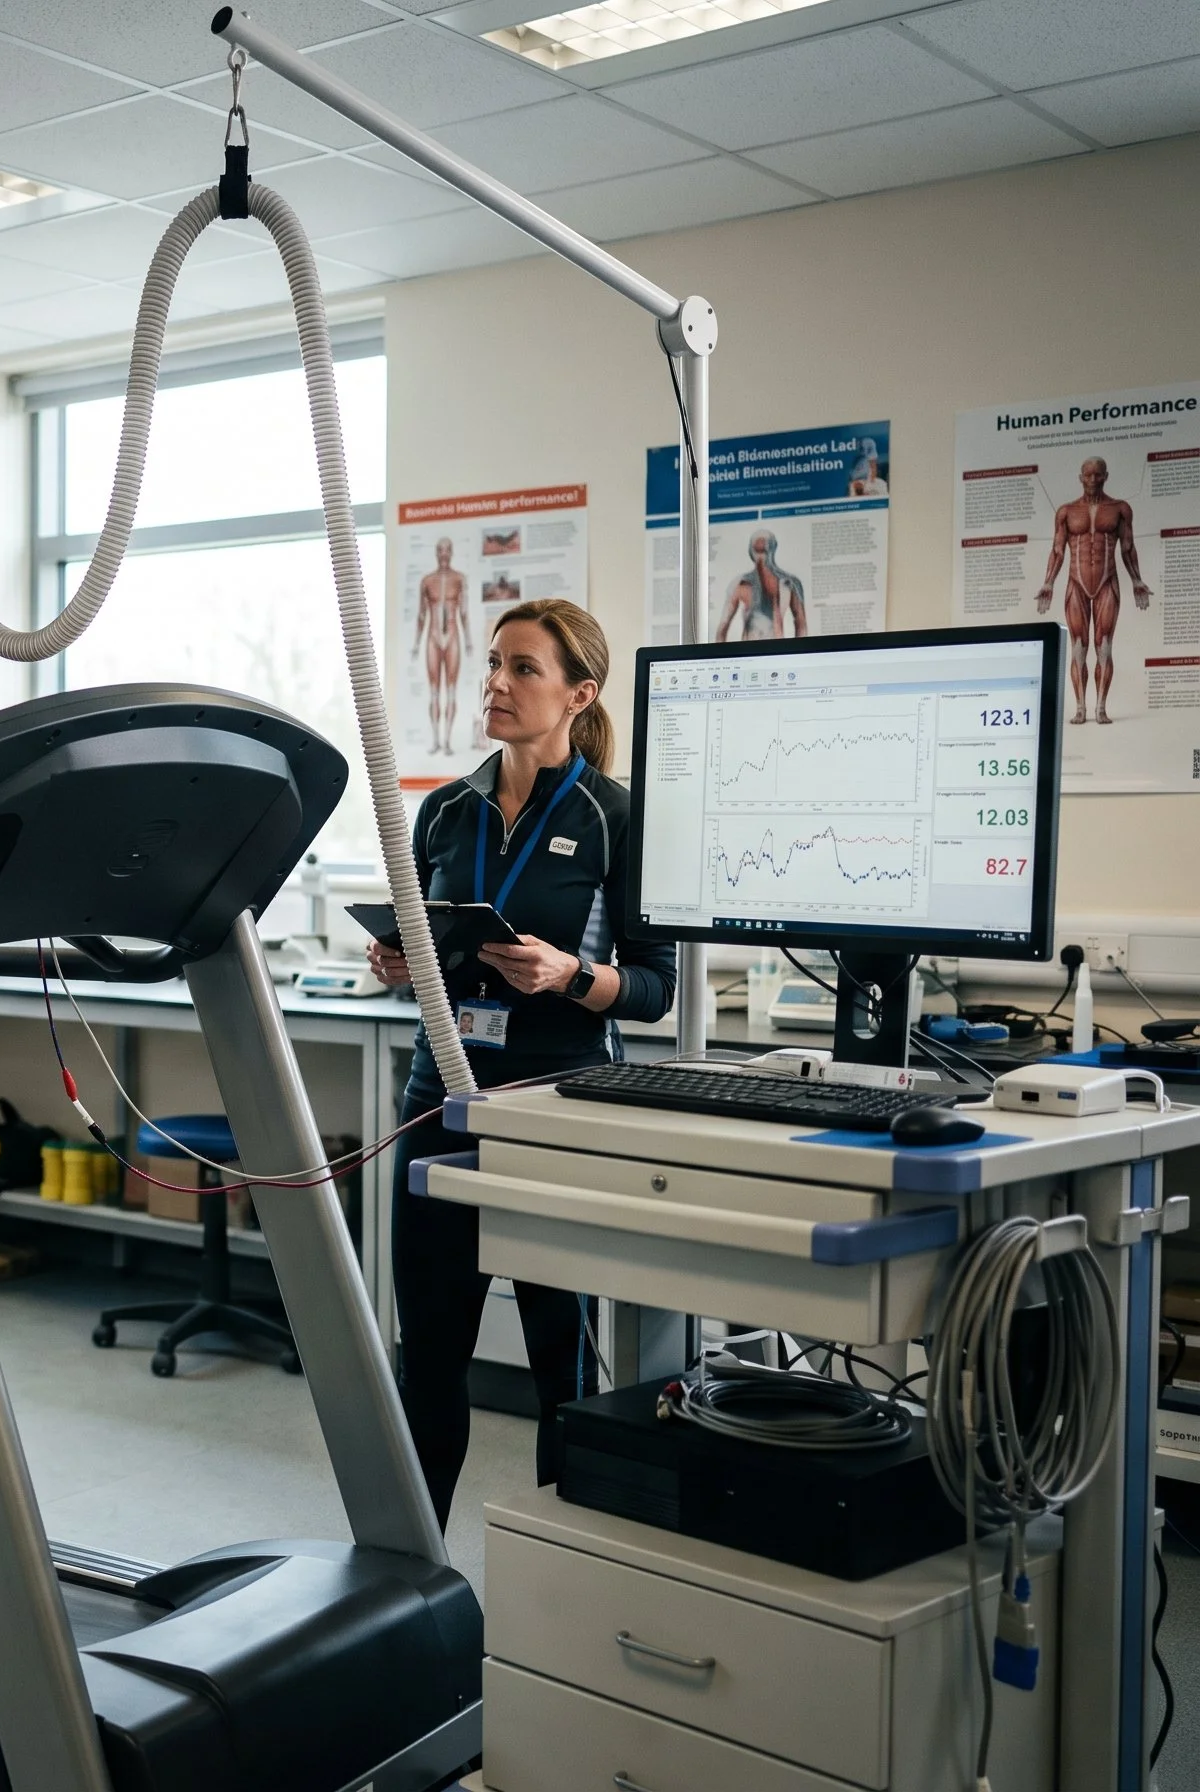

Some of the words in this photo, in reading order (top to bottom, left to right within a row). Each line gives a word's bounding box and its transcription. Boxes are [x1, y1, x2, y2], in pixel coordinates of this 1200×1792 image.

[997, 413, 1063, 431] Human
[1068, 397, 1197, 424] Performance
[980, 709, 1030, 727] 123.1
[978, 759, 1030, 777] 13.56
[976, 809, 1029, 826] 12.03
[986, 858, 1028, 876] 82.7
